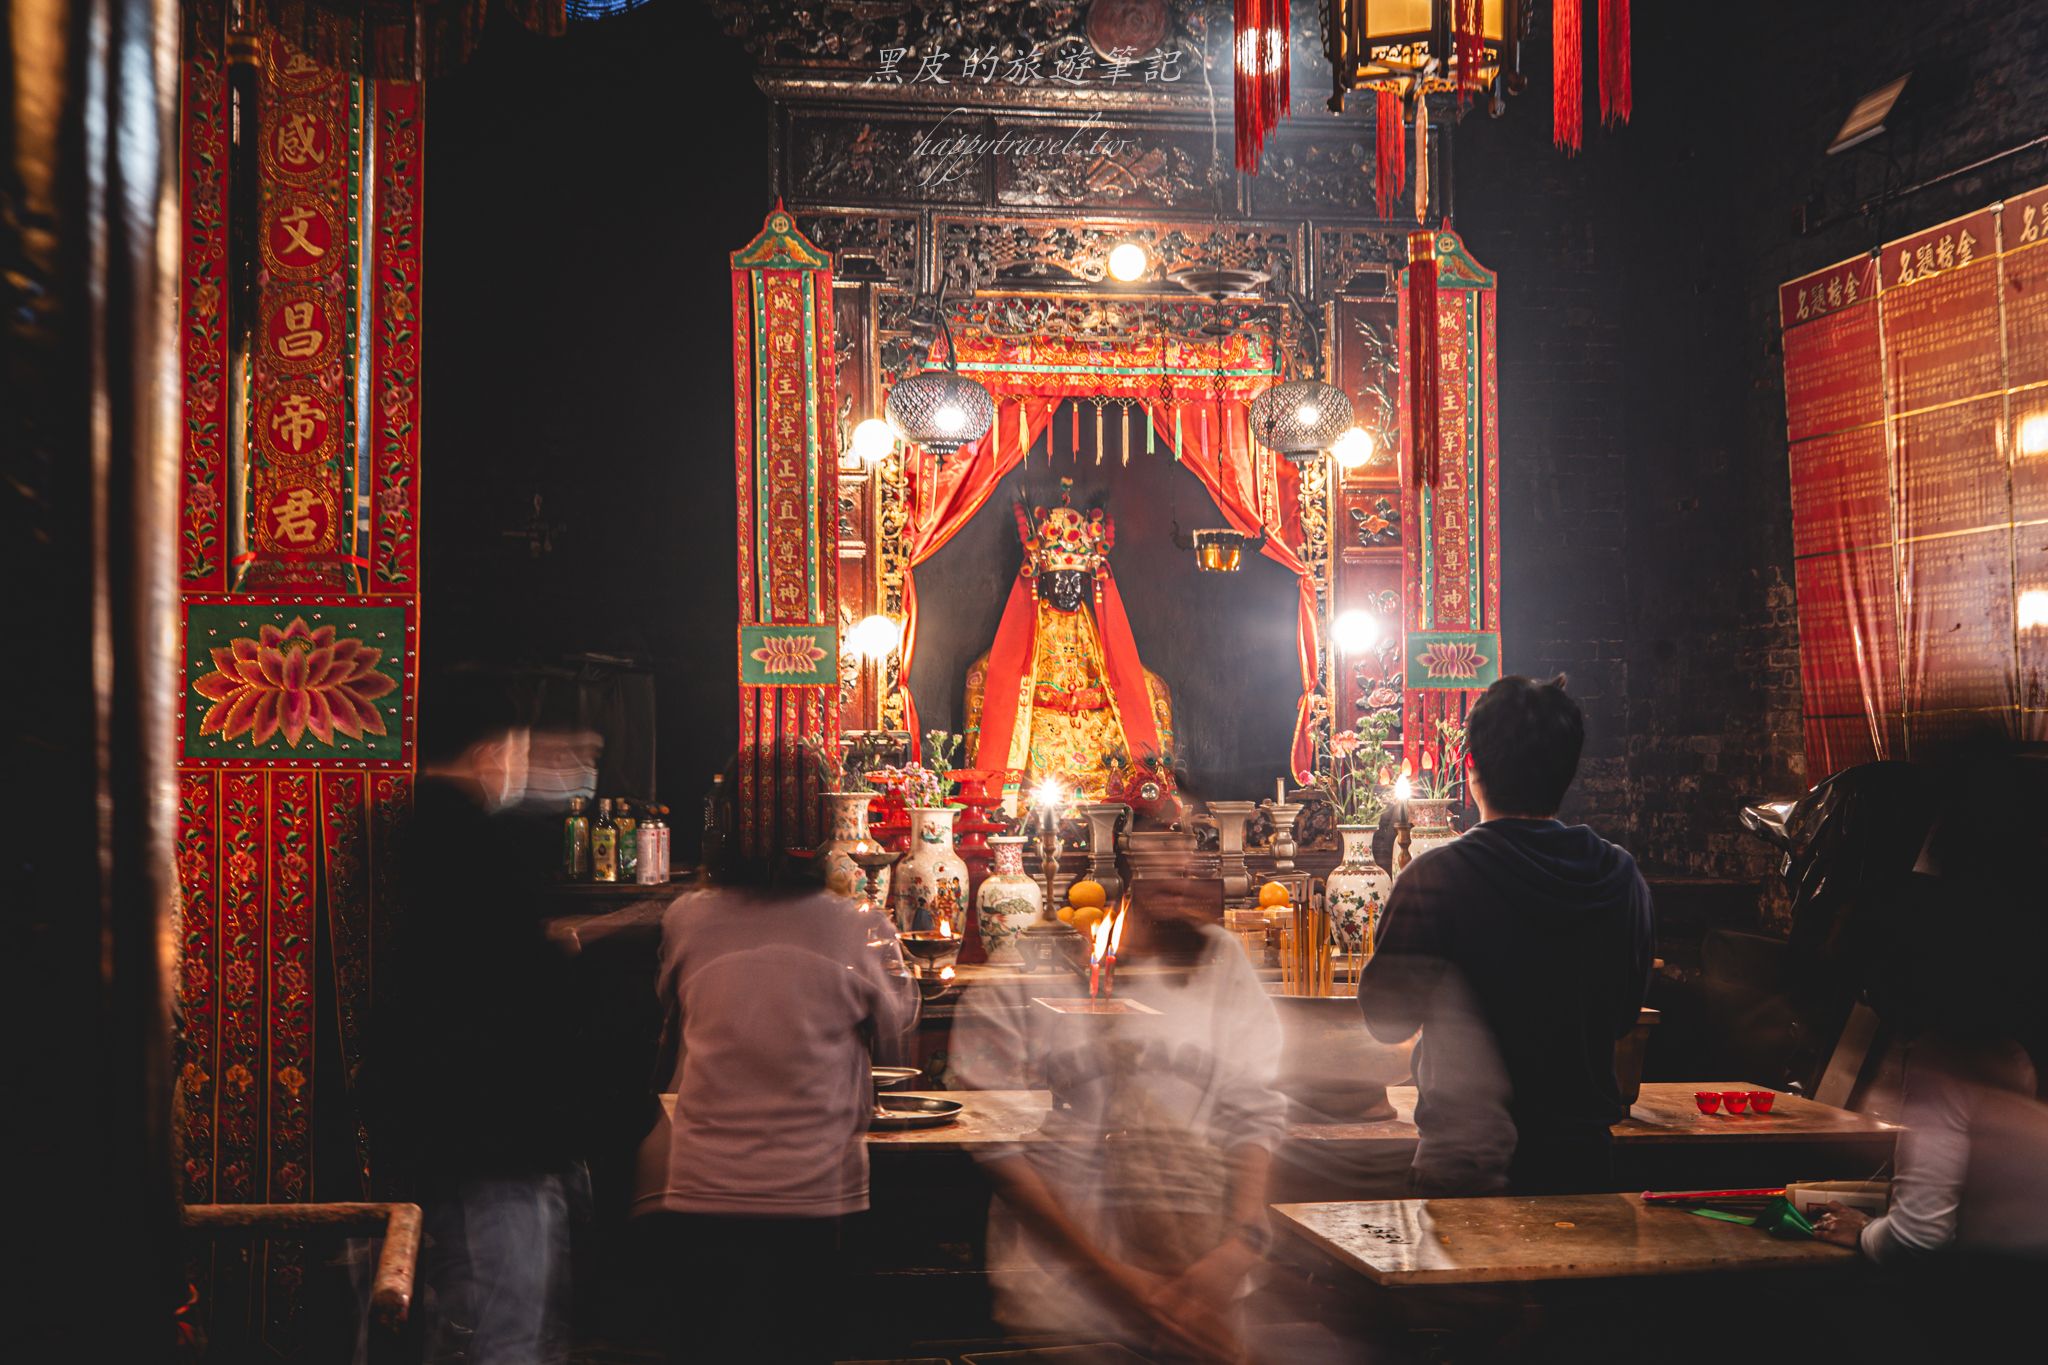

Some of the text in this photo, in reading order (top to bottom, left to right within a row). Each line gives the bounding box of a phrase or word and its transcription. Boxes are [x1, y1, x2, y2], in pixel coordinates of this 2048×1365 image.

[773, 291, 800, 605] 城隍主宰正直尊神
[1439, 311, 1463, 610] 城隍主宰正直尊神
